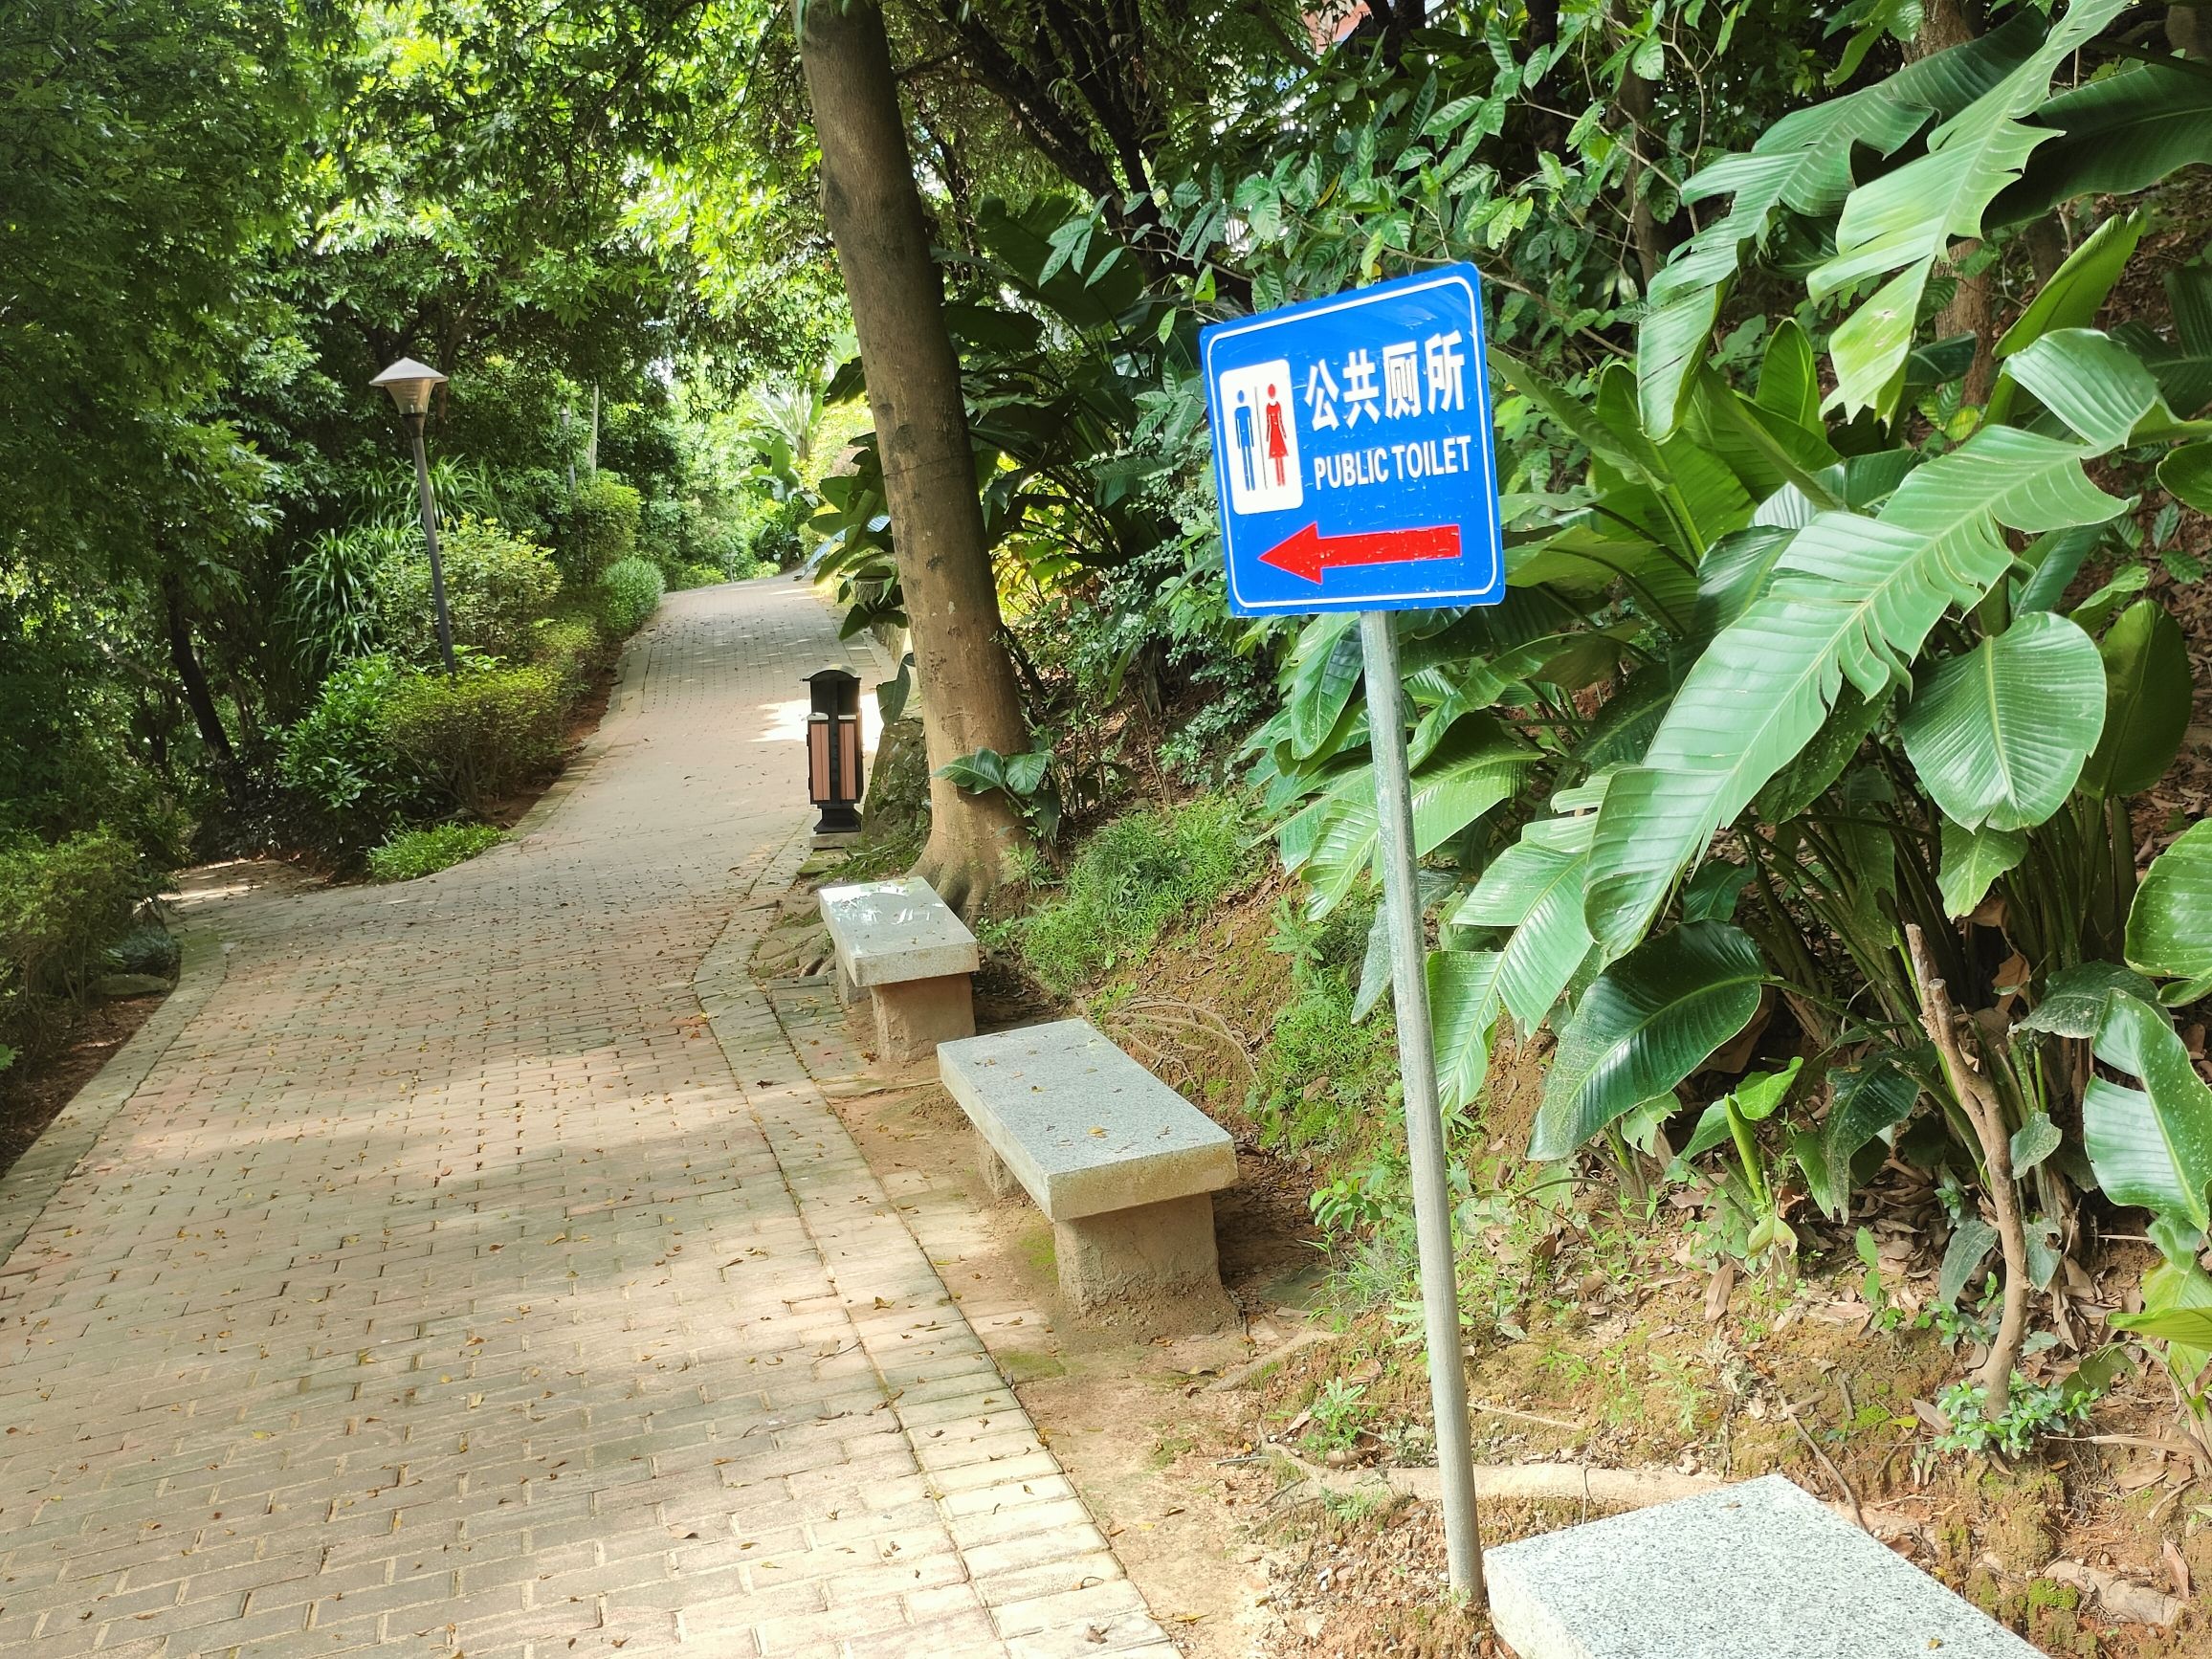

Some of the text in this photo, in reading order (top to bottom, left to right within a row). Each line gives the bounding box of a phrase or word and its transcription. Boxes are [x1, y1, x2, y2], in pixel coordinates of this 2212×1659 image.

[1304, 329, 1466, 431] 公共厕所
[1314, 435, 1471, 491] PUBLIC TOILET
